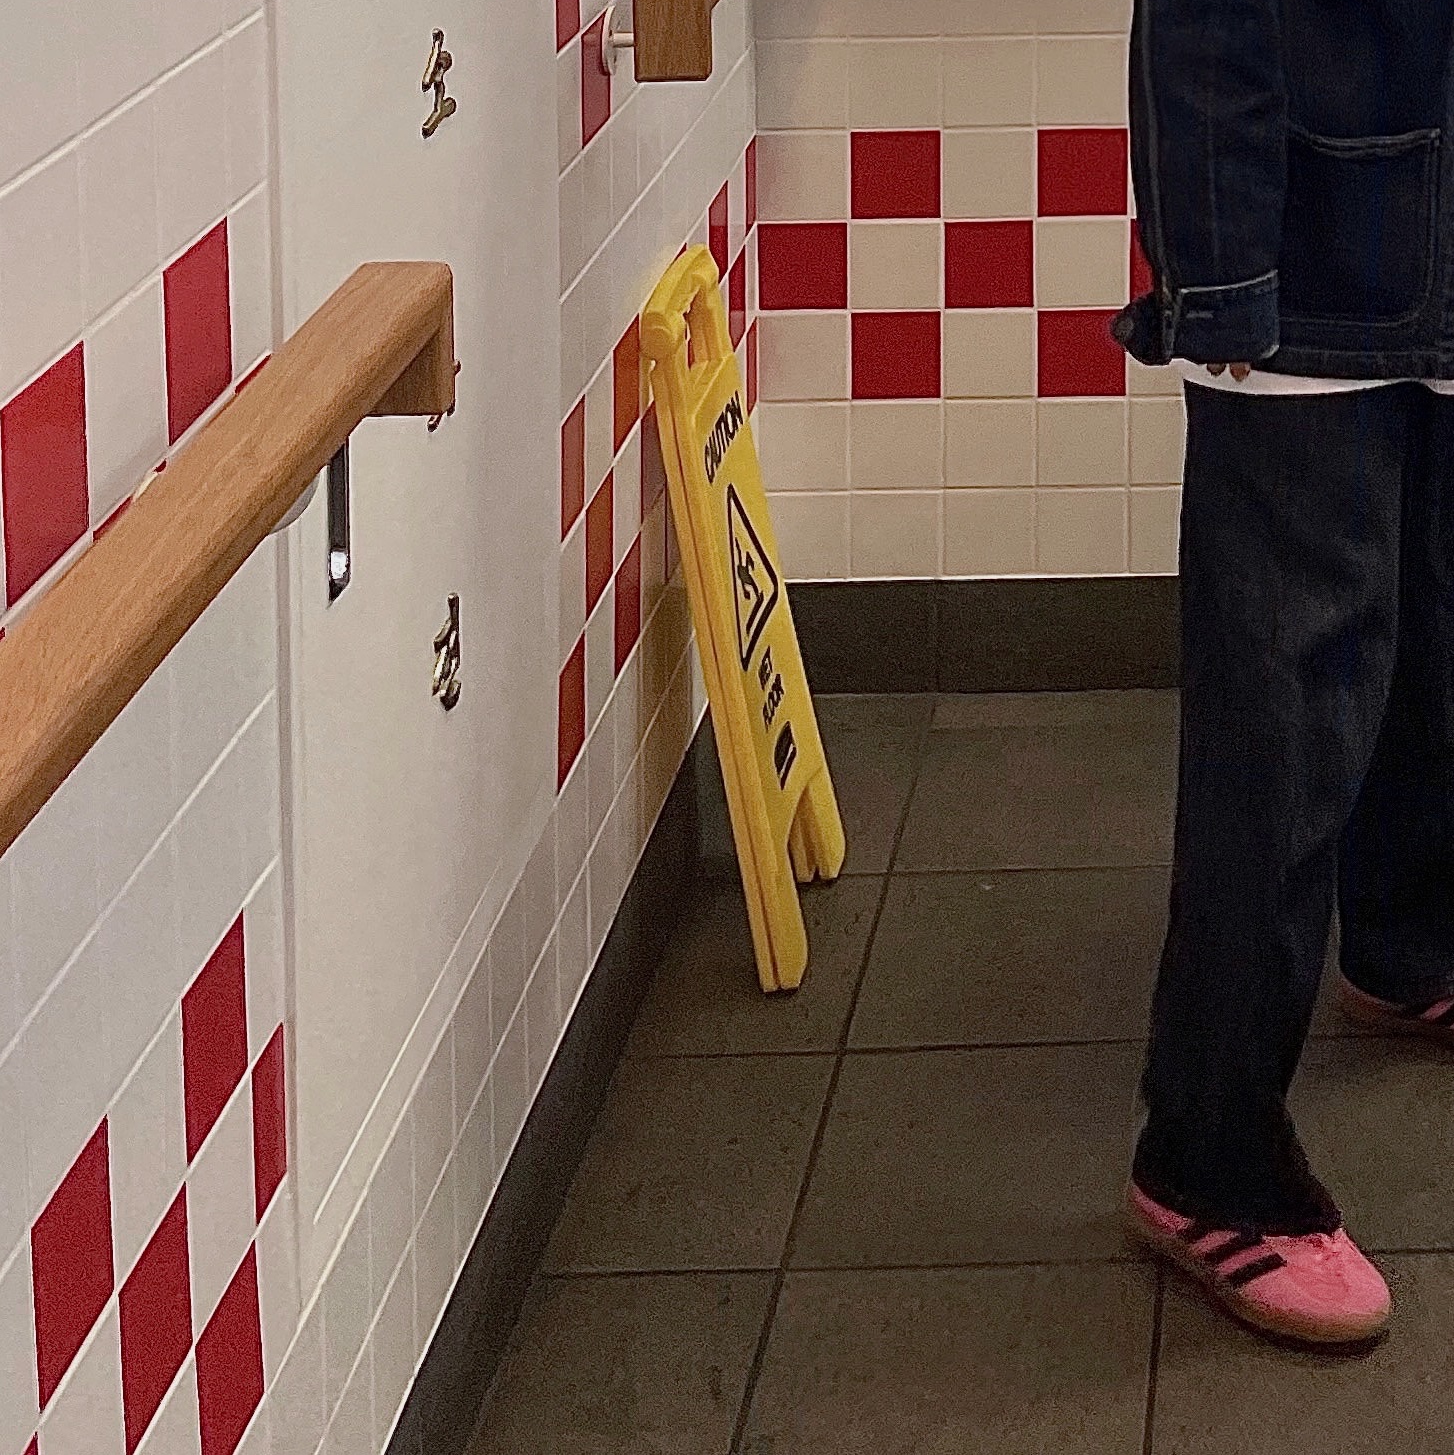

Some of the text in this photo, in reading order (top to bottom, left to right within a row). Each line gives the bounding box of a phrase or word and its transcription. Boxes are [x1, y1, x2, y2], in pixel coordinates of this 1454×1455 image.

[704, 390, 743, 484] CAUTION
[758, 645, 773, 691] WET
[763, 673, 784, 733] FLOOR
